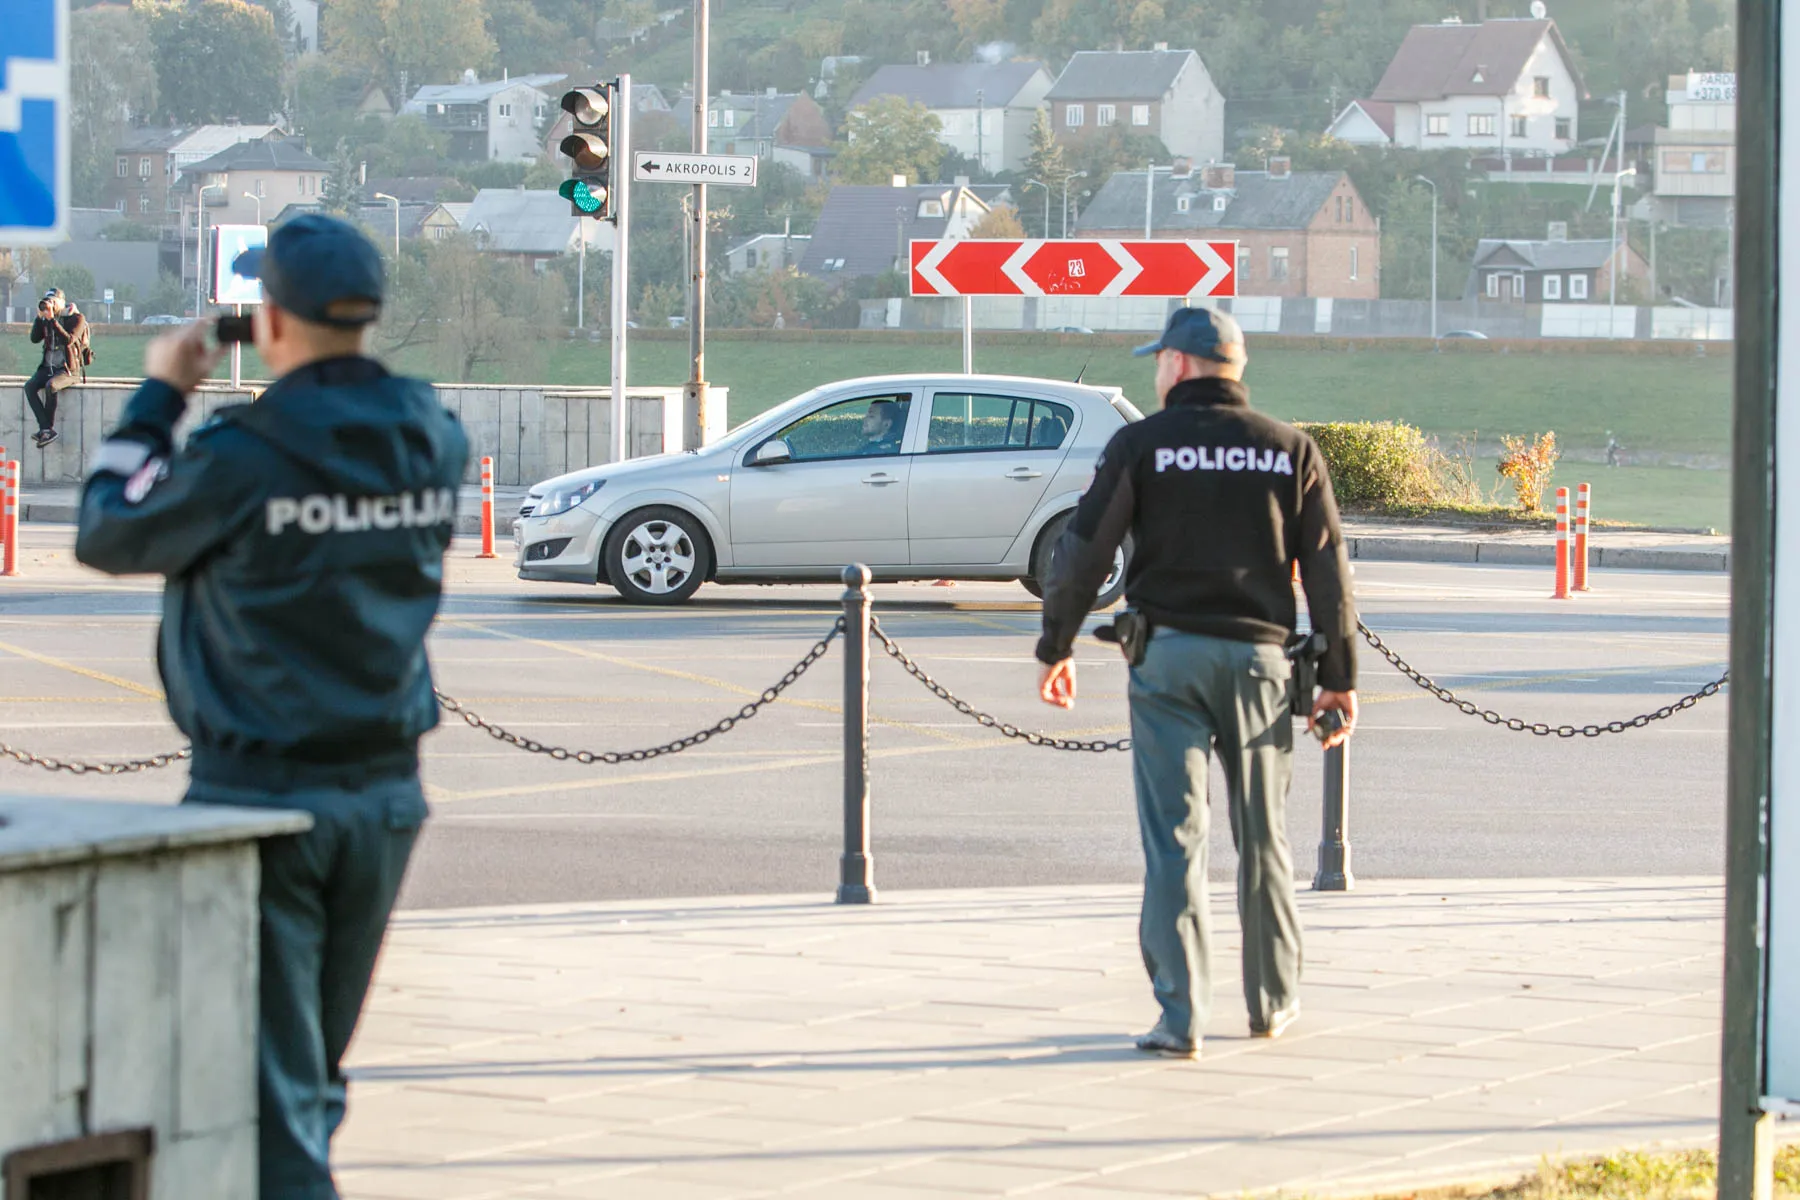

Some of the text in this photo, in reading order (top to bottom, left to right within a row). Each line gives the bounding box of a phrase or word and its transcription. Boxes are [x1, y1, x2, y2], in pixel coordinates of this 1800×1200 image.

[665, 163, 751, 177] AKROPOLIS 2
[1070, 261, 1083, 275] 23
[1155, 446, 1293, 476] POLICIJA
[266, 487, 456, 535] POLICIJA
